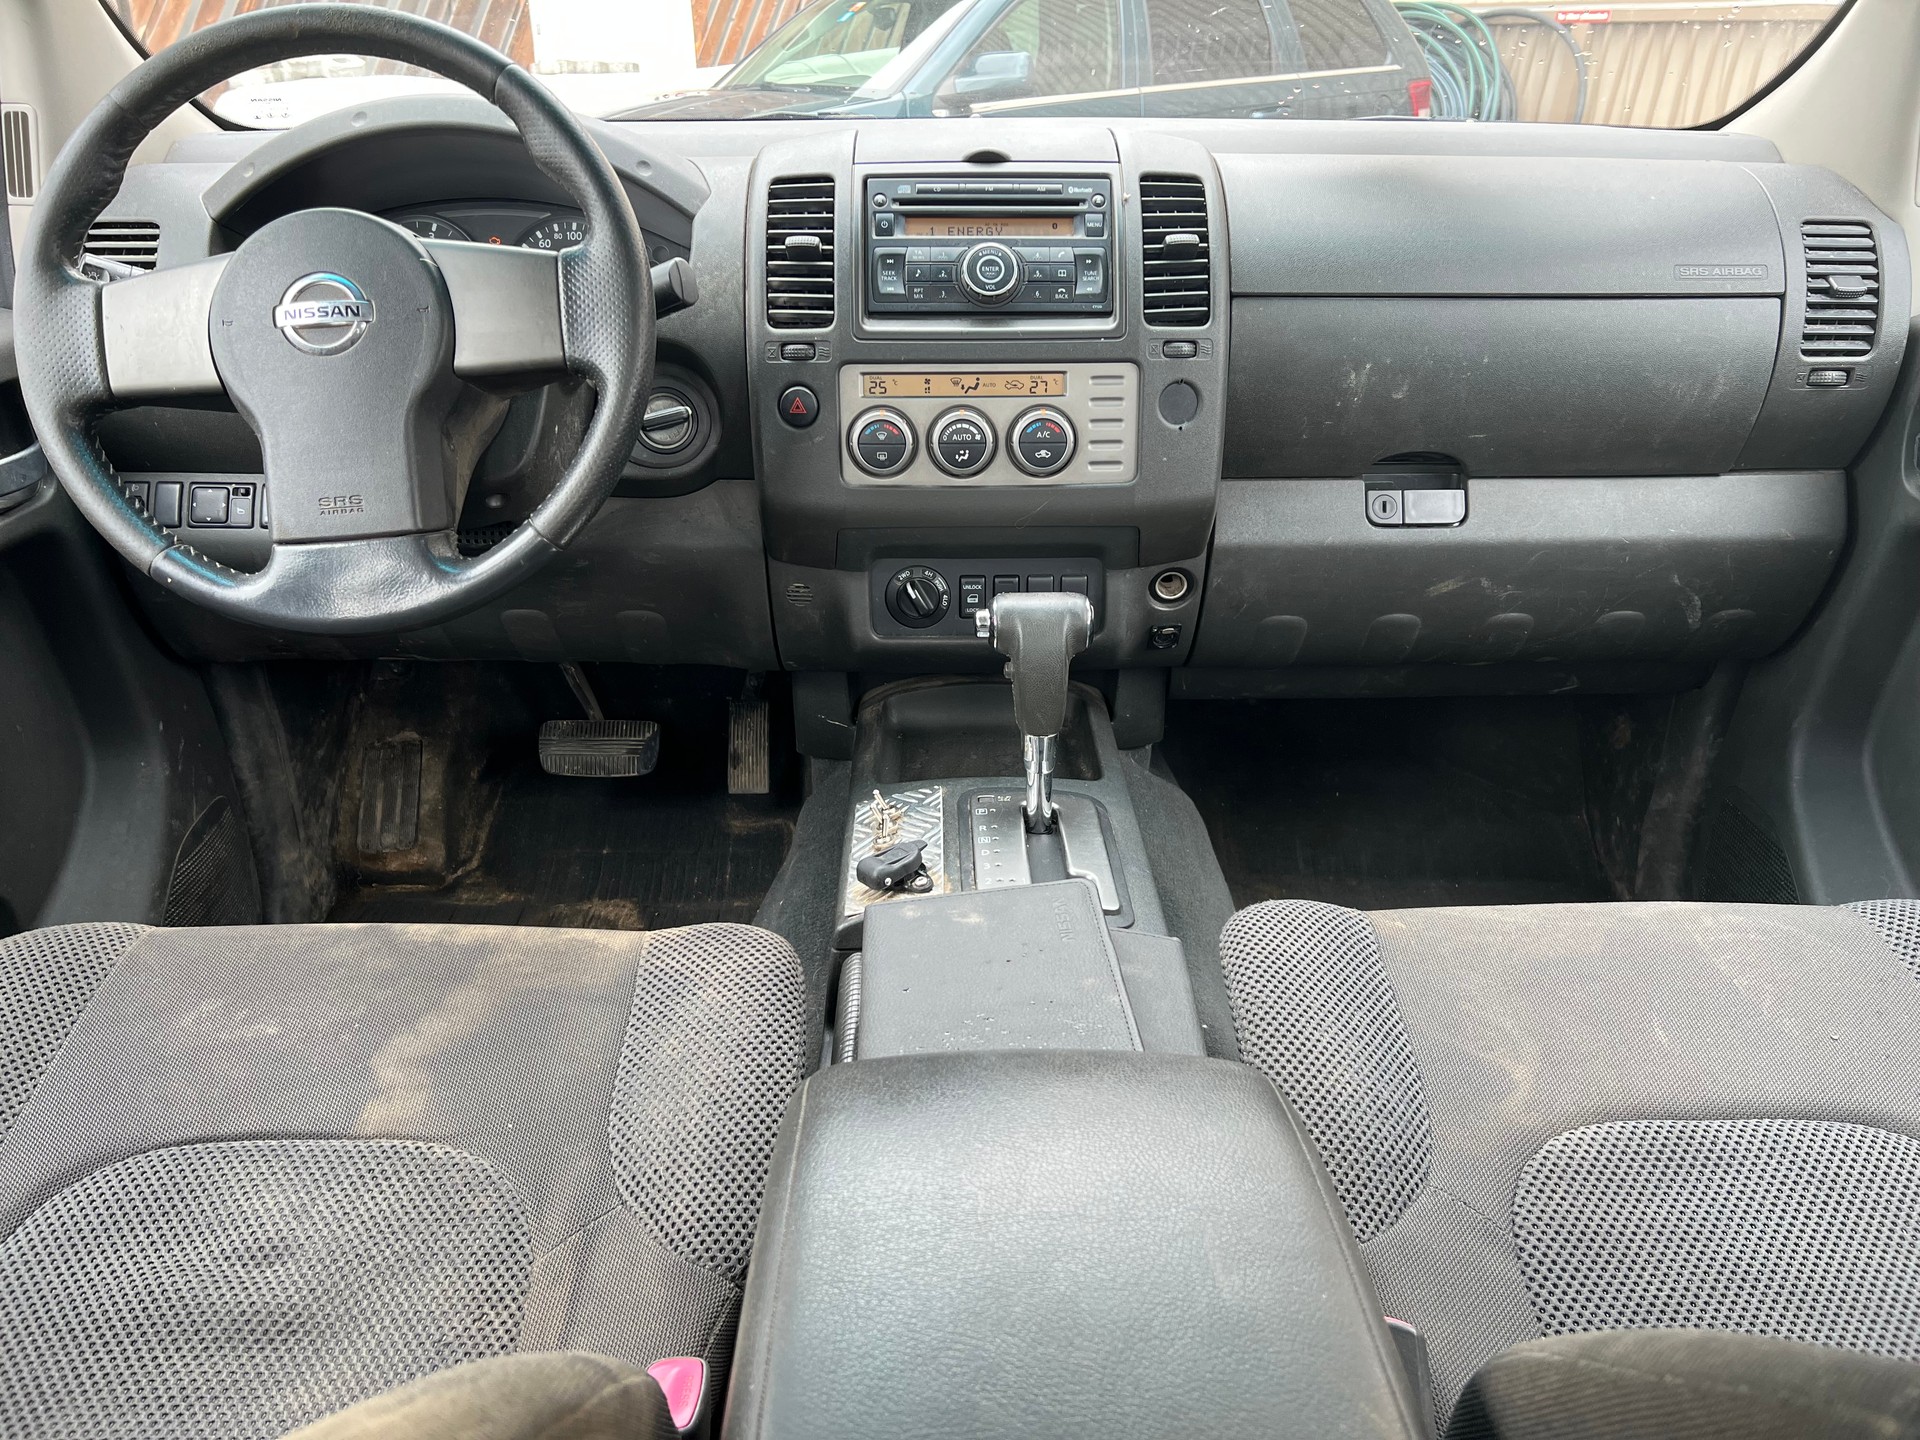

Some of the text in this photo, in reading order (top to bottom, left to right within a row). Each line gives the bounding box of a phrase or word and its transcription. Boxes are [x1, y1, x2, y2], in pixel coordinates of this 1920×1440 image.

[947, 226, 1003, 236] ENERGY
[538, 239, 551, 248] 60
[566, 231, 583, 241] 100
[1680, 267, 1762, 276] SRS AIRBAG
[284, 305, 360, 320] NISSAN
[869, 381, 887, 394] 25
[1029, 381, 1048, 394] 27
[318, 495, 363, 506] SRS
[320, 507, 364, 516] AIRBAG
[898, 570, 911, 580] 2WD
[934, 580, 944, 592] PUSH
